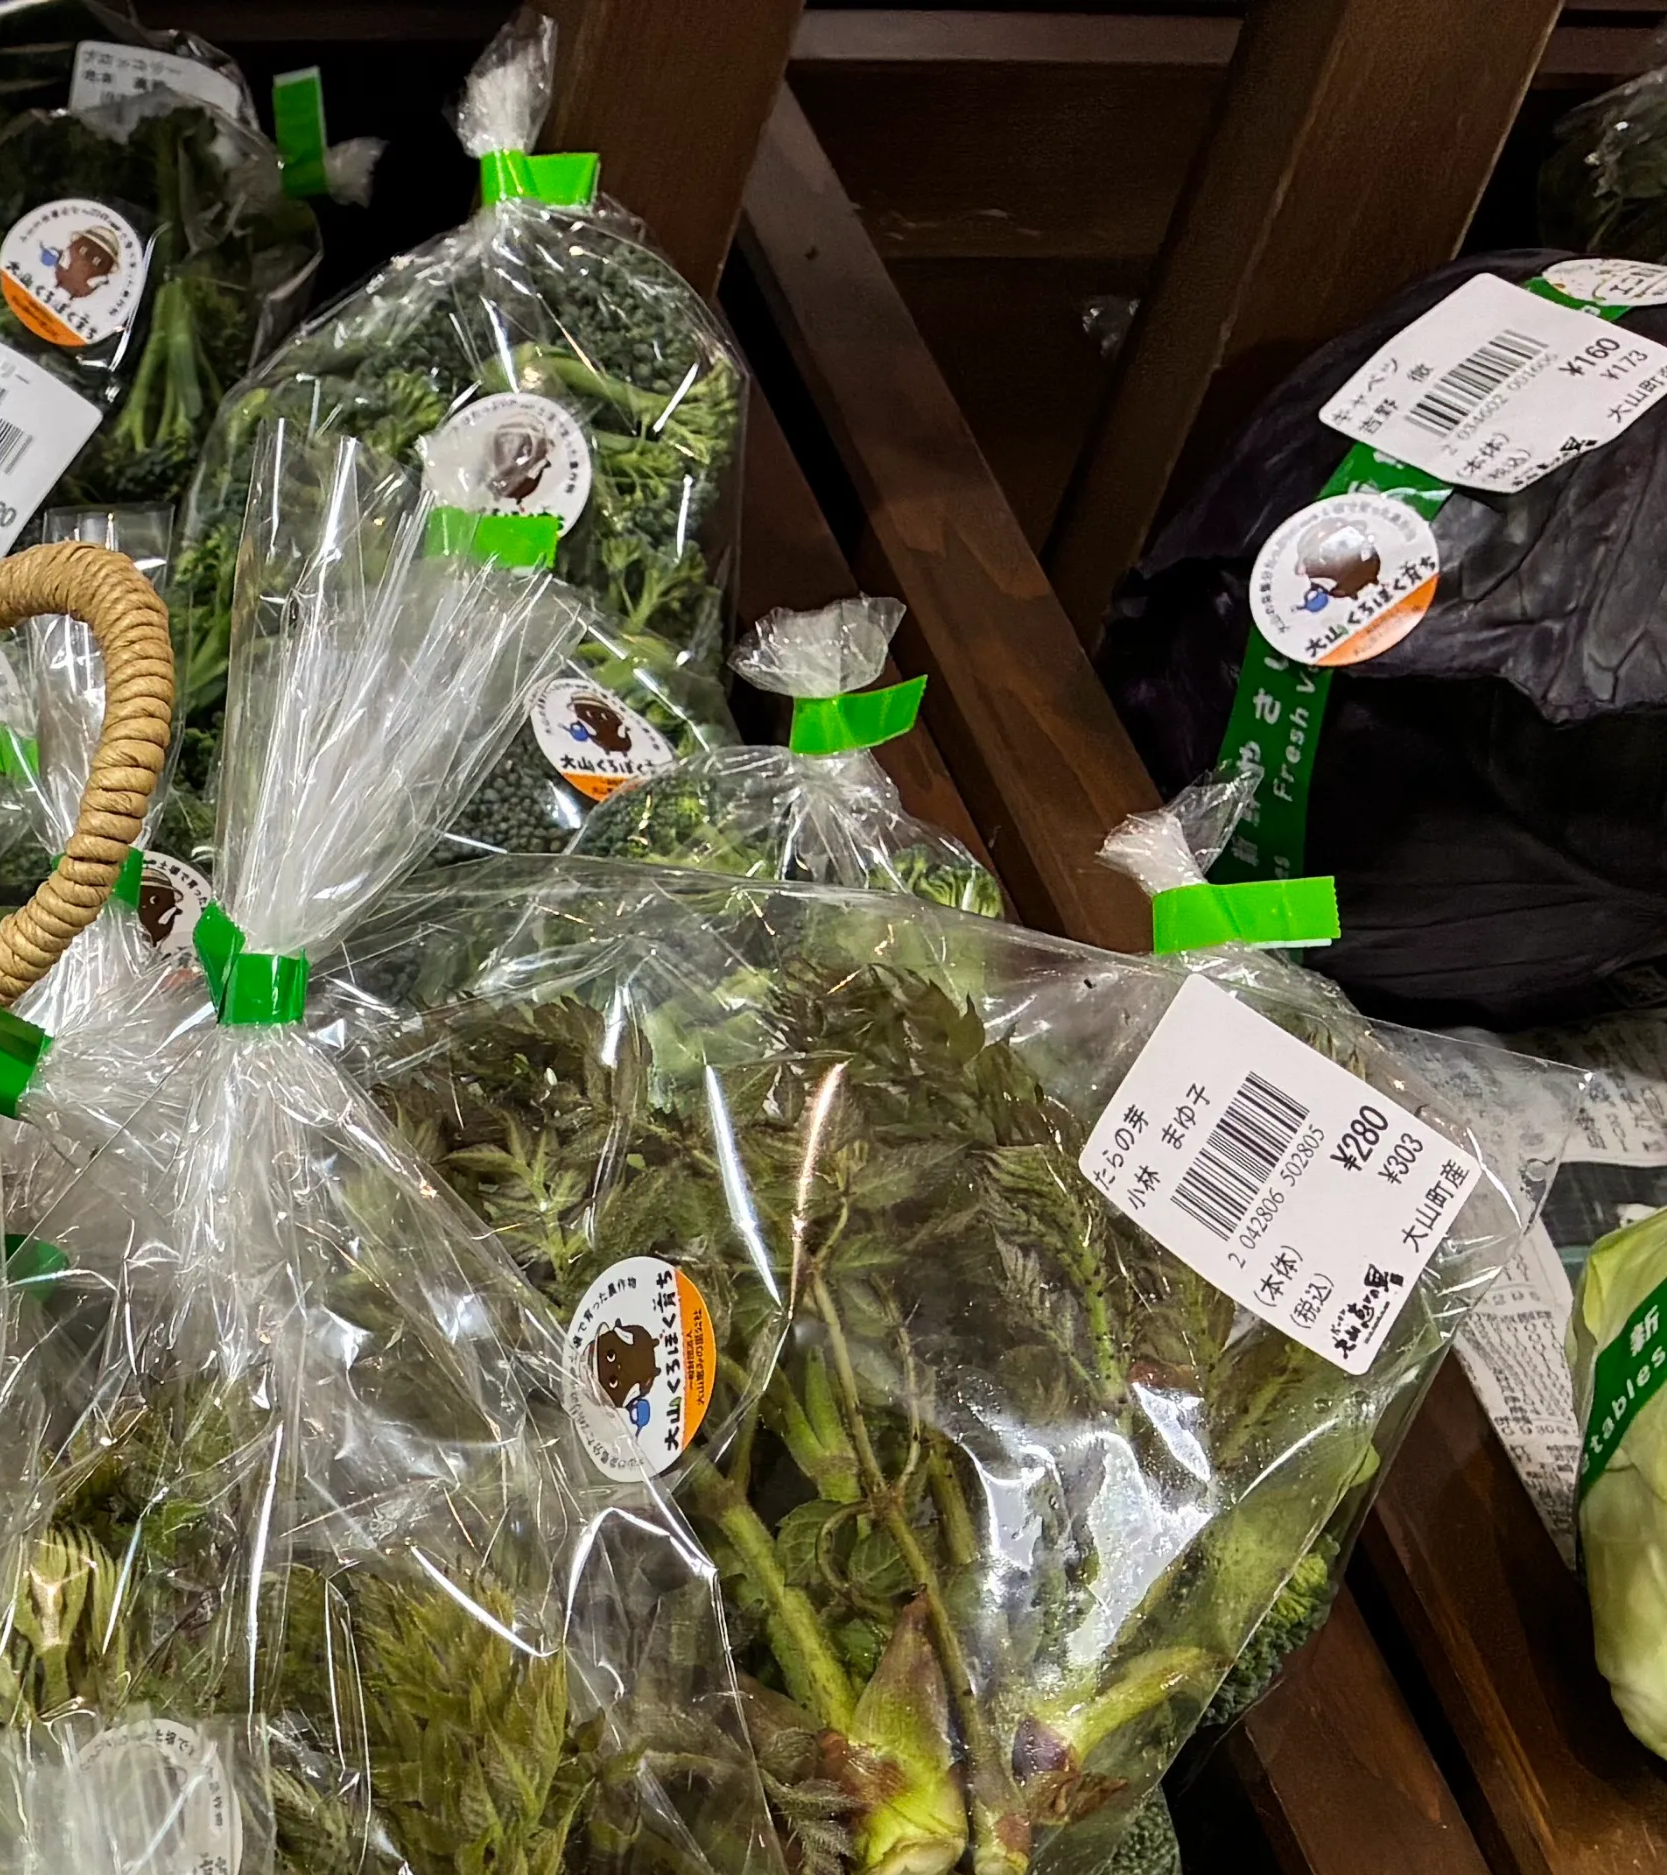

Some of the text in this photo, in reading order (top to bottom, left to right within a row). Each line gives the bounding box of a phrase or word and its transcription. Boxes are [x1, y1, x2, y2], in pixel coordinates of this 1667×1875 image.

[1557, 334, 1623, 379] ¥160
[1598, 347, 1650, 383] ¥173
[1273, 707, 1310, 802] Fresh
[1086, 1101, 1154, 1192] たらの芽
[1121, 1078, 1216, 1213] 小林 まゆ子
[1237, 1121, 1328, 1253] 042806 502805
[1251, 1099, 1392, 1312] (本体) ¥280
[1287, 1128, 1426, 1334] (税込) ¥303
[1397, 1153, 1471, 1256] 大山町産
[652, 1270, 678, 1451] 大山くろぼく育ち
